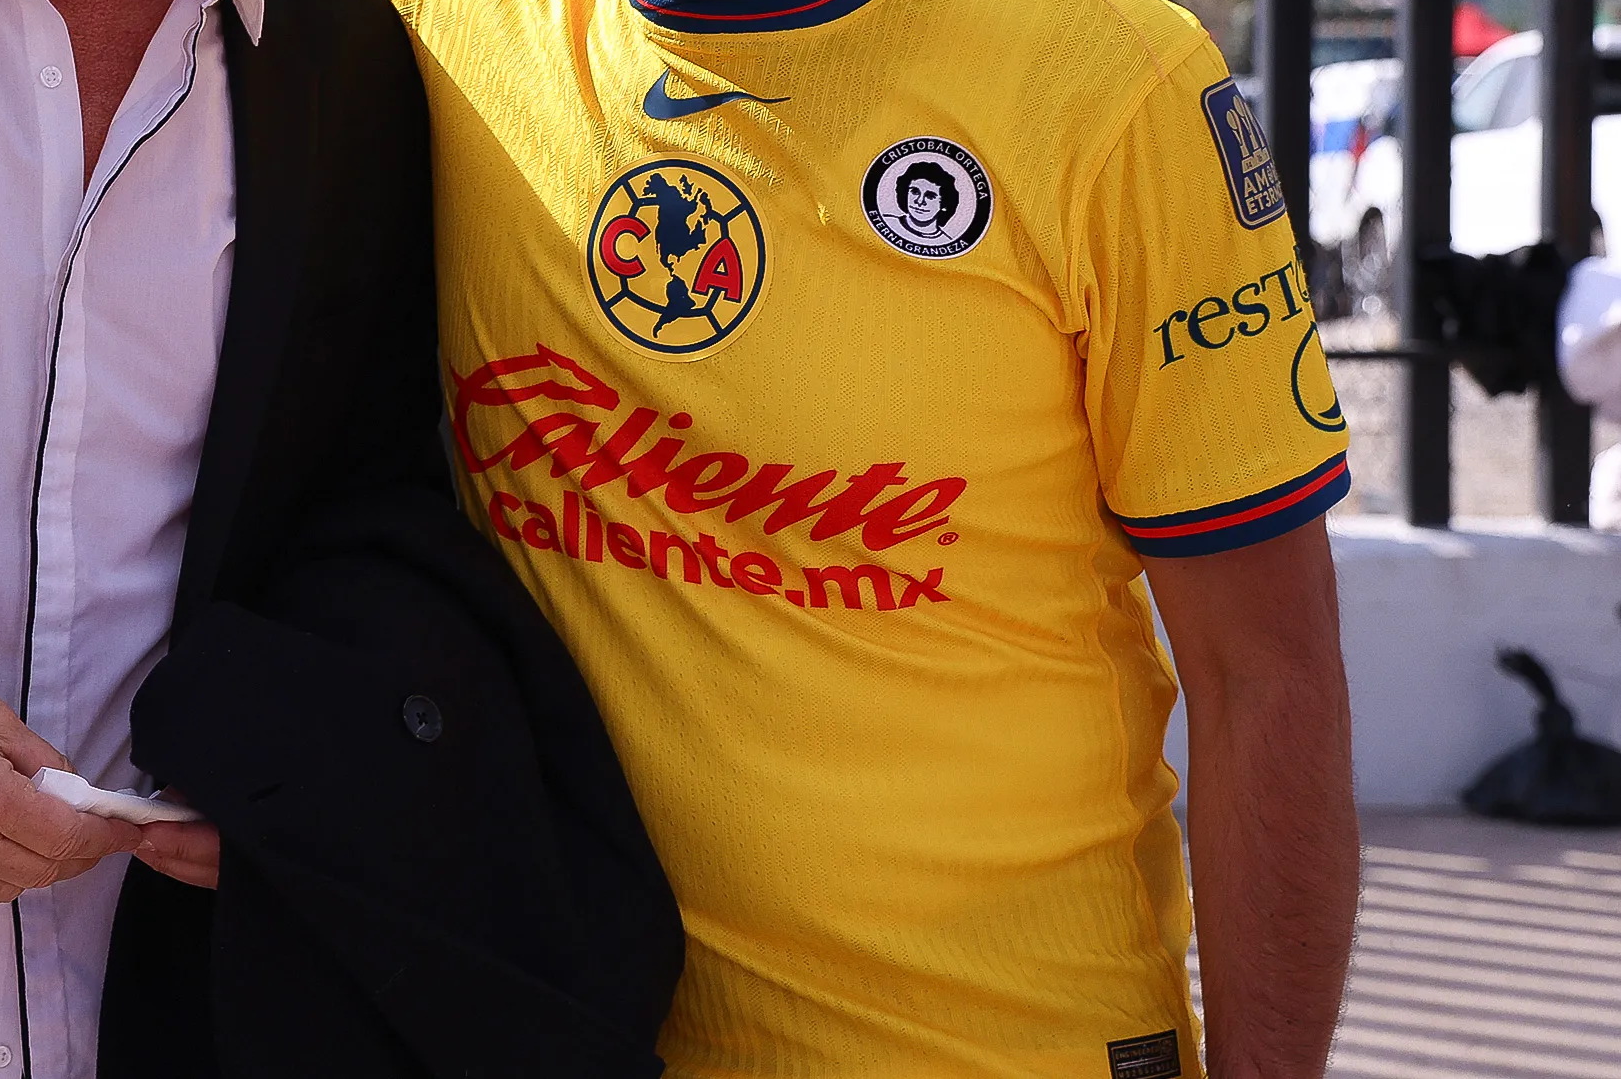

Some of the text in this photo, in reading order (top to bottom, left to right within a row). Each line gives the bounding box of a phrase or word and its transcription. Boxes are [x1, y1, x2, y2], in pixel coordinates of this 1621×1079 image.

[882, 141, 988, 200] CRISTOBAL ORTEGA
[868, 209, 969, 256] ETERNA GRANDEZA
[489, 490, 952, 612] caliente.mx
